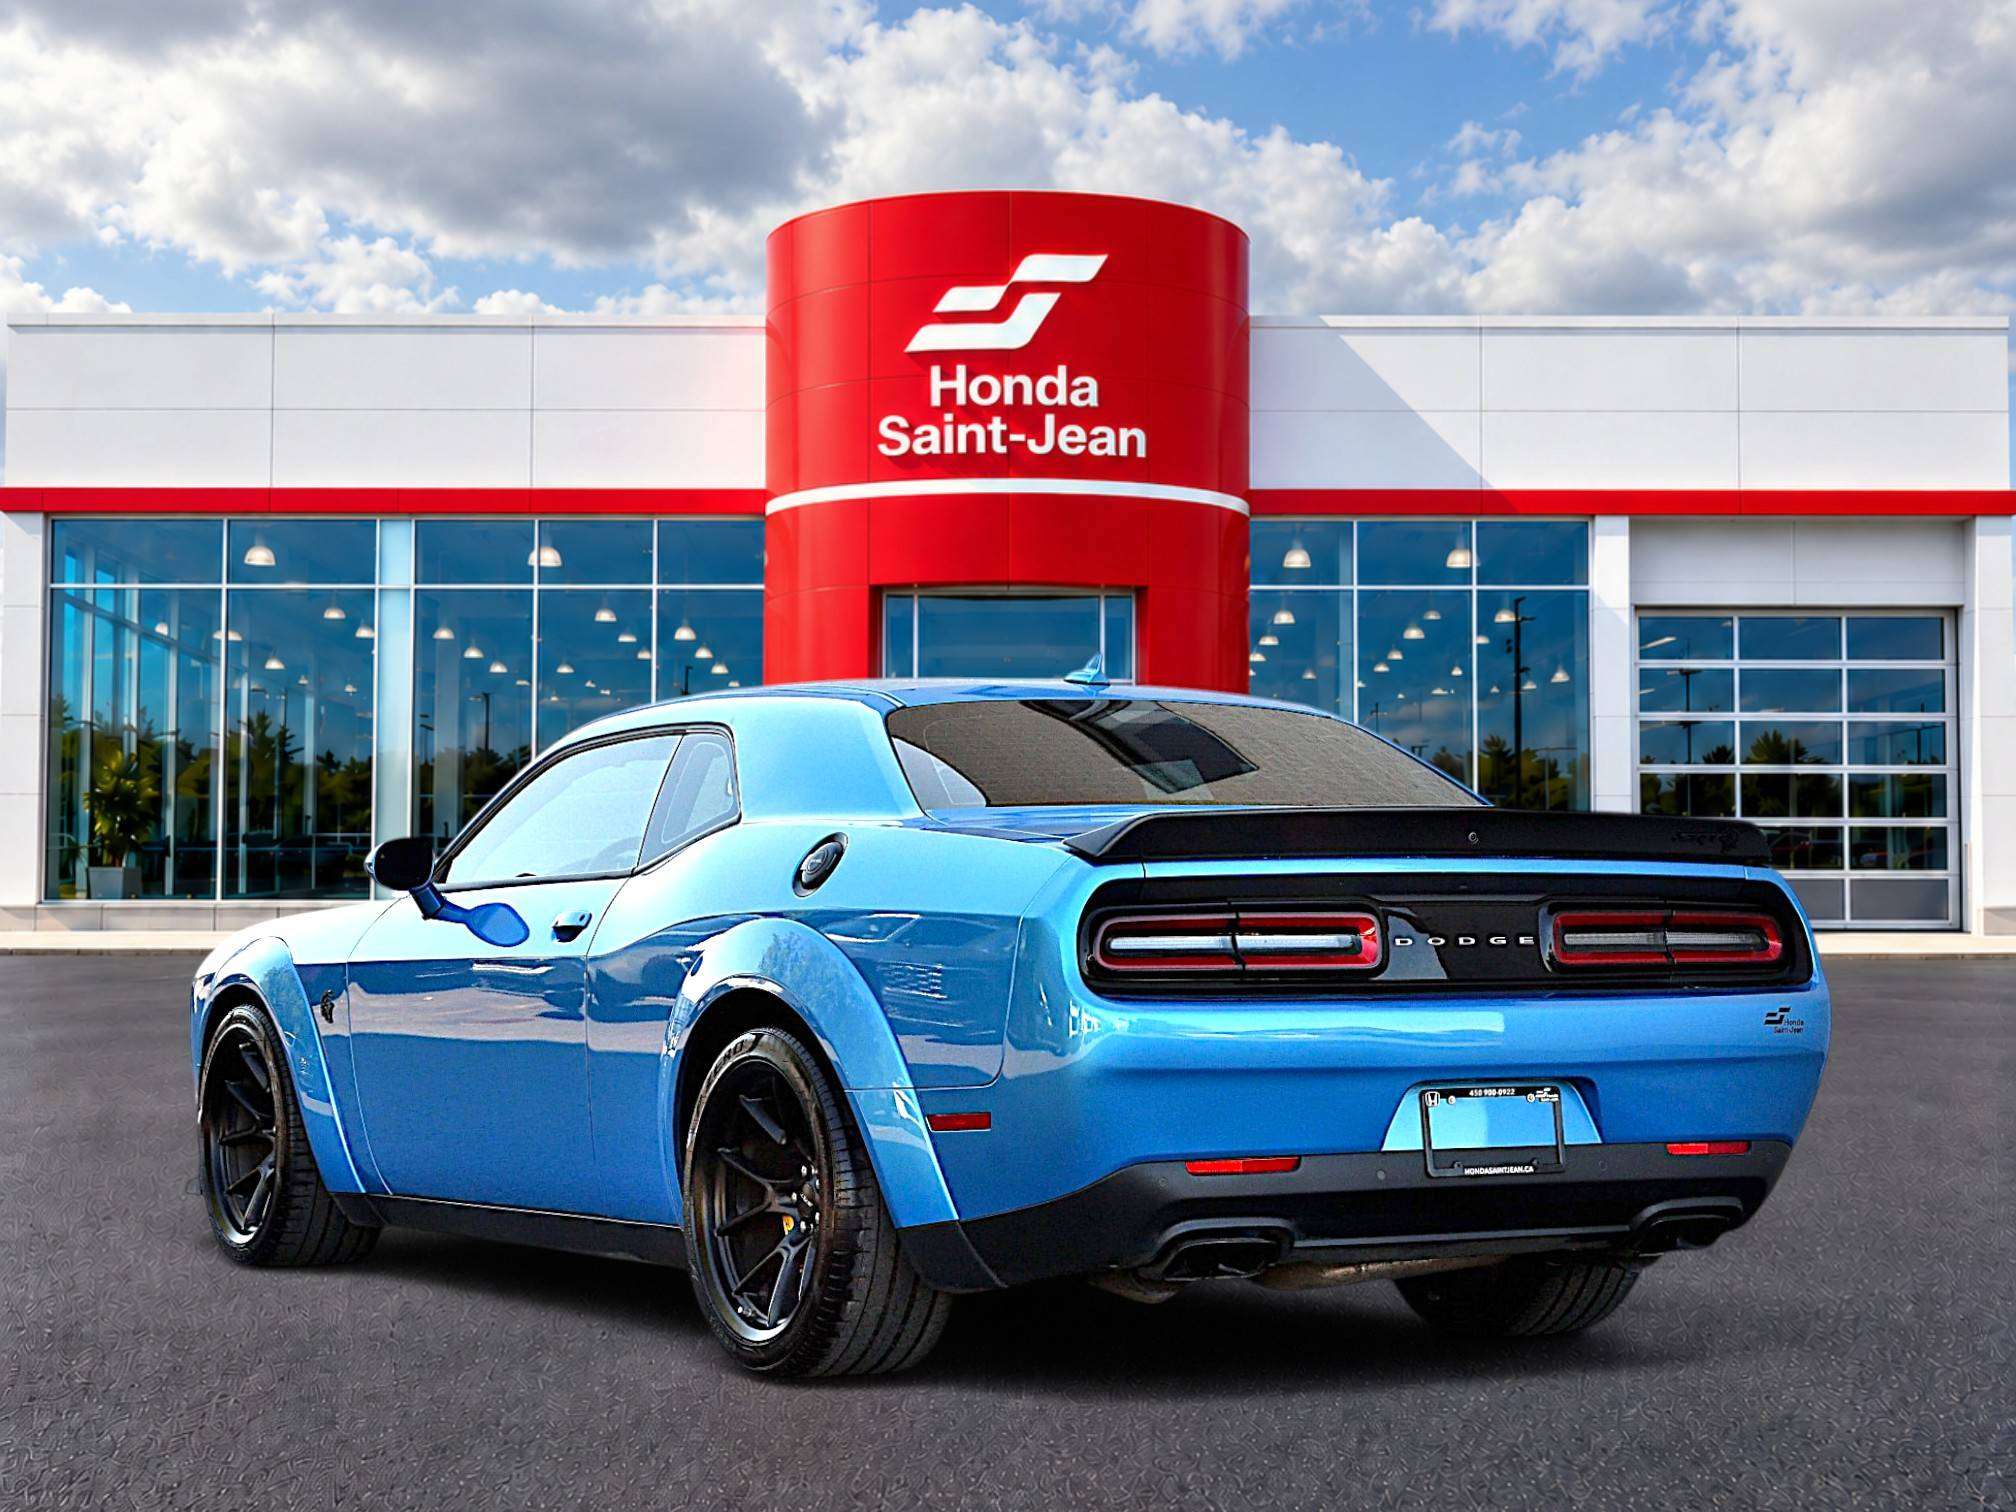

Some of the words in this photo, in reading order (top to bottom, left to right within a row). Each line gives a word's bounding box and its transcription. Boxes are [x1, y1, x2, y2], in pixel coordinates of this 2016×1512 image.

[930, 364, 1099, 407] Honda
[877, 412, 1147, 458] Saint-Jean
[1394, 936, 1535, 946] DODGE
[1464, 1165, 1535, 1175] HONDASAINTJEAN.CA
